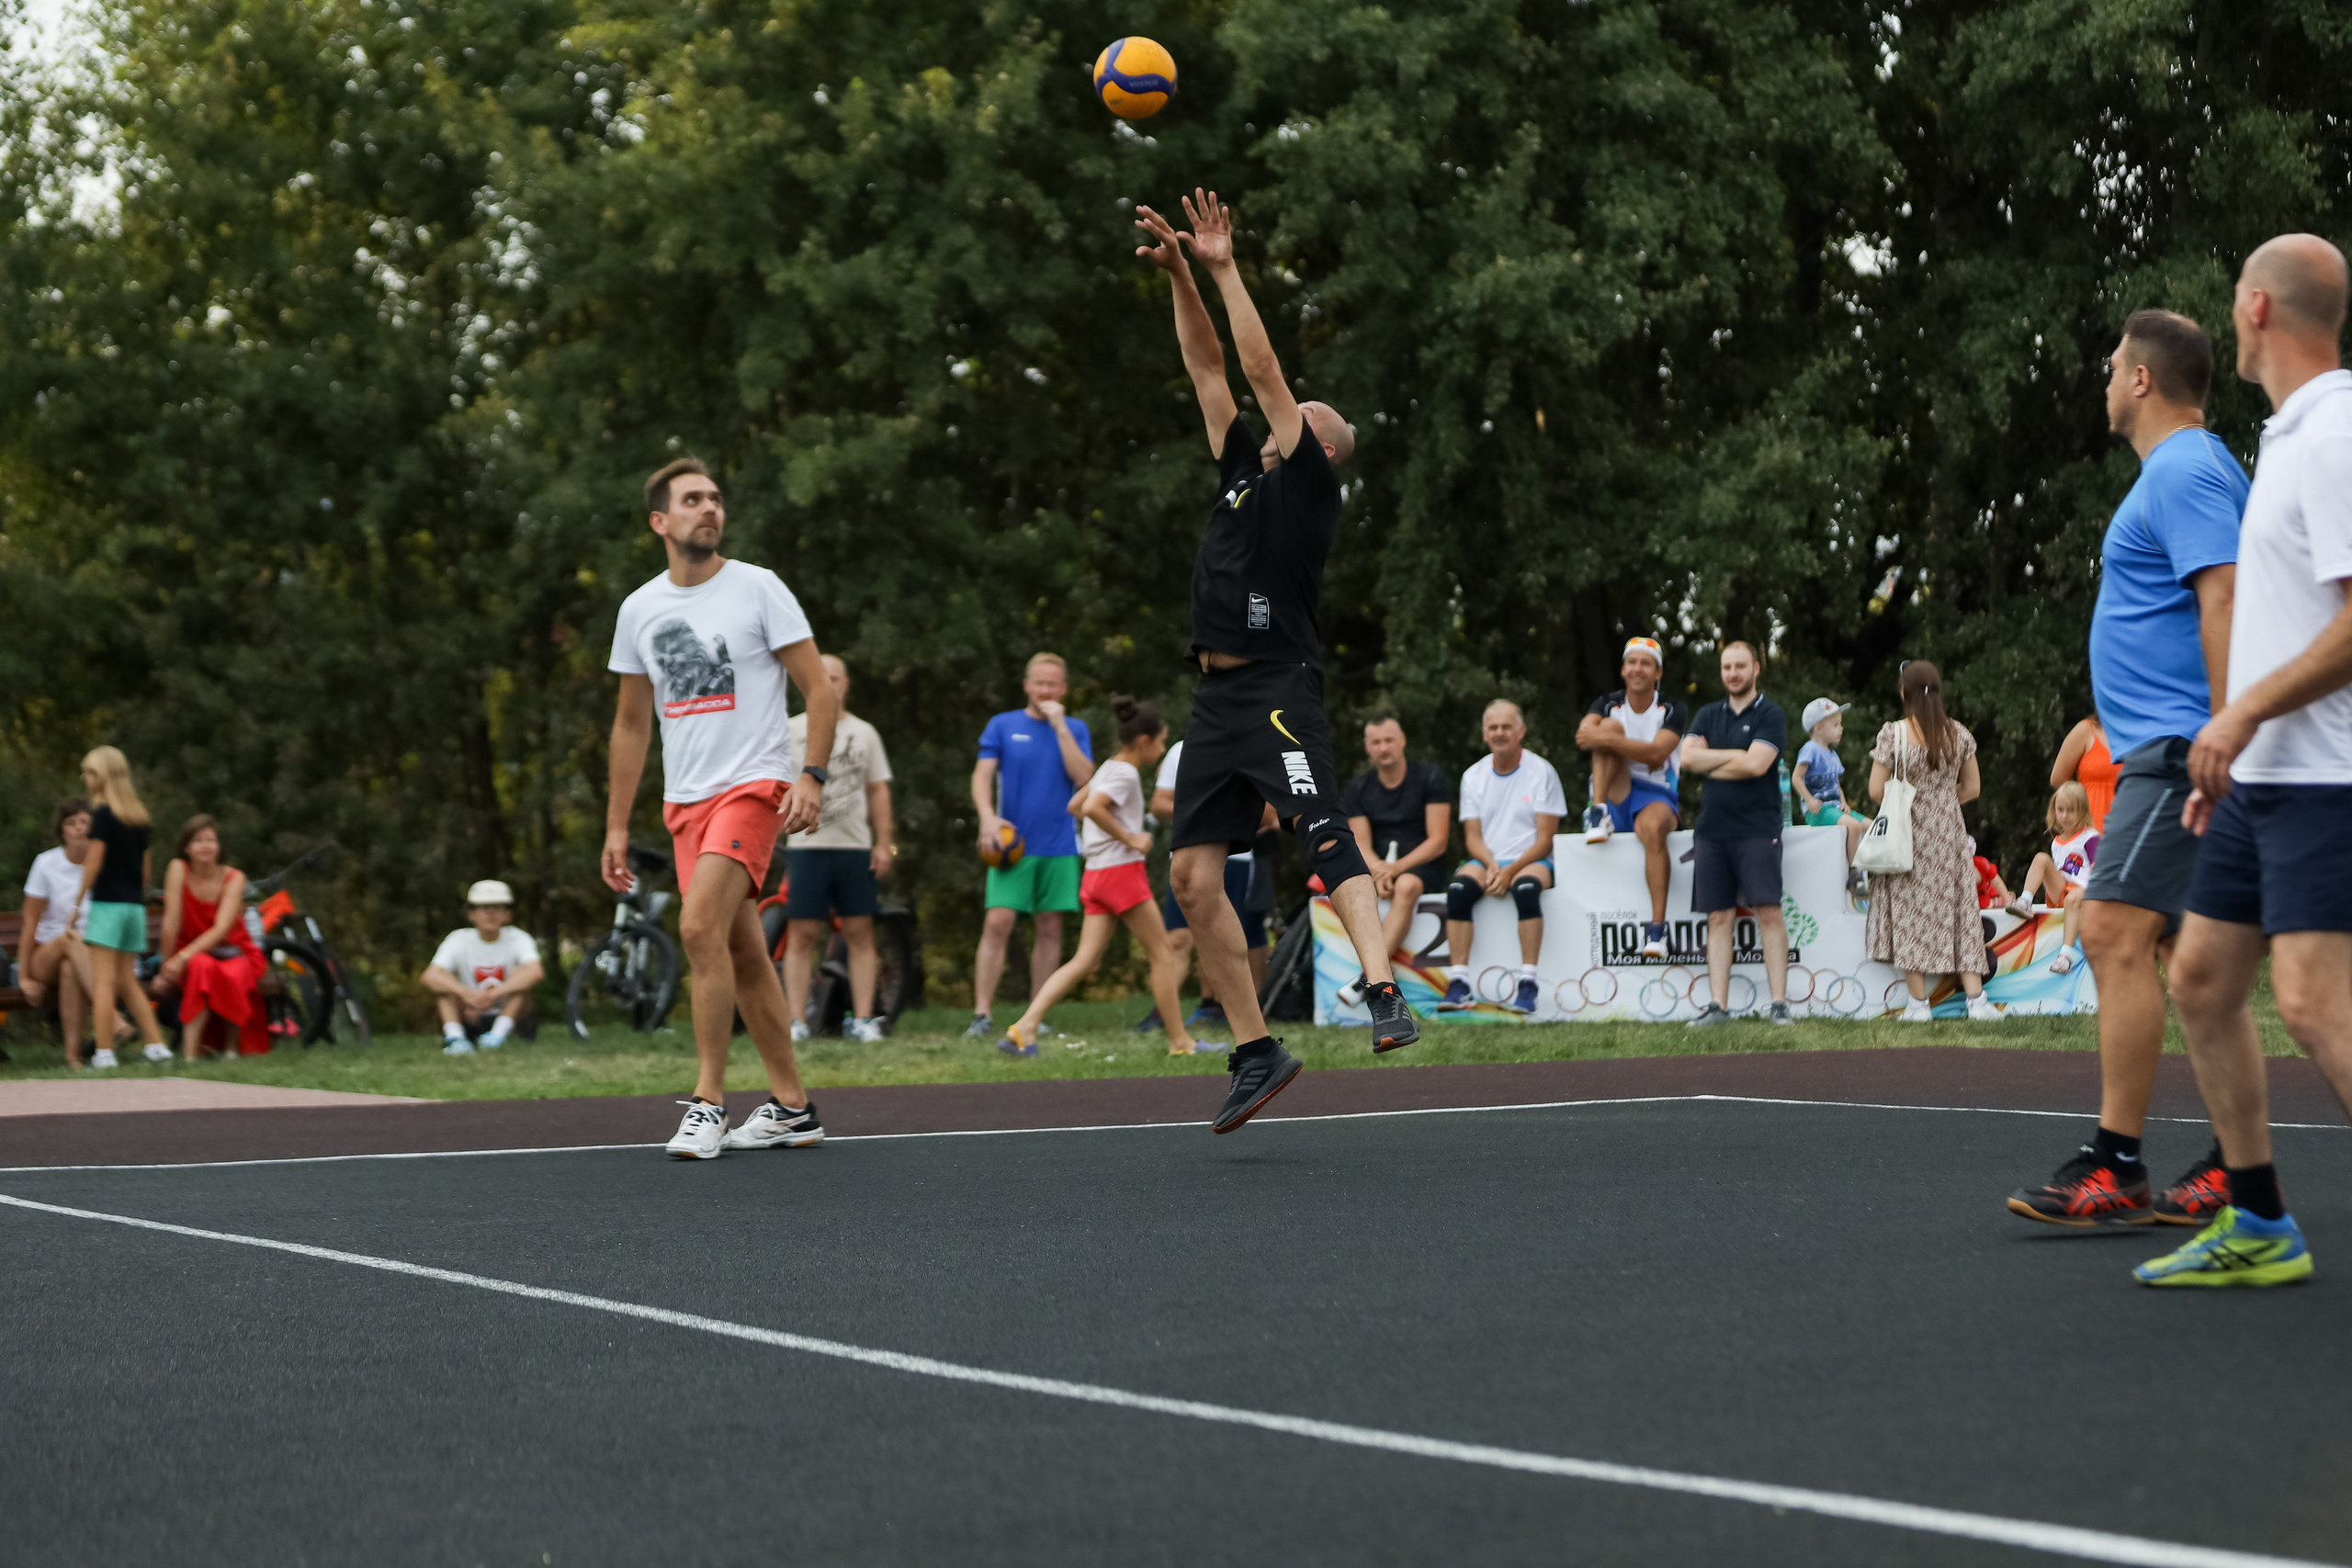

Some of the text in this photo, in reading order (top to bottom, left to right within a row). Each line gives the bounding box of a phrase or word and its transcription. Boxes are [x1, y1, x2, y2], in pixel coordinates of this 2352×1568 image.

[1281, 750, 1318, 795] NIKE
[1412, 901, 1453, 969] 2
[1607, 953, 1642, 965] Моя
